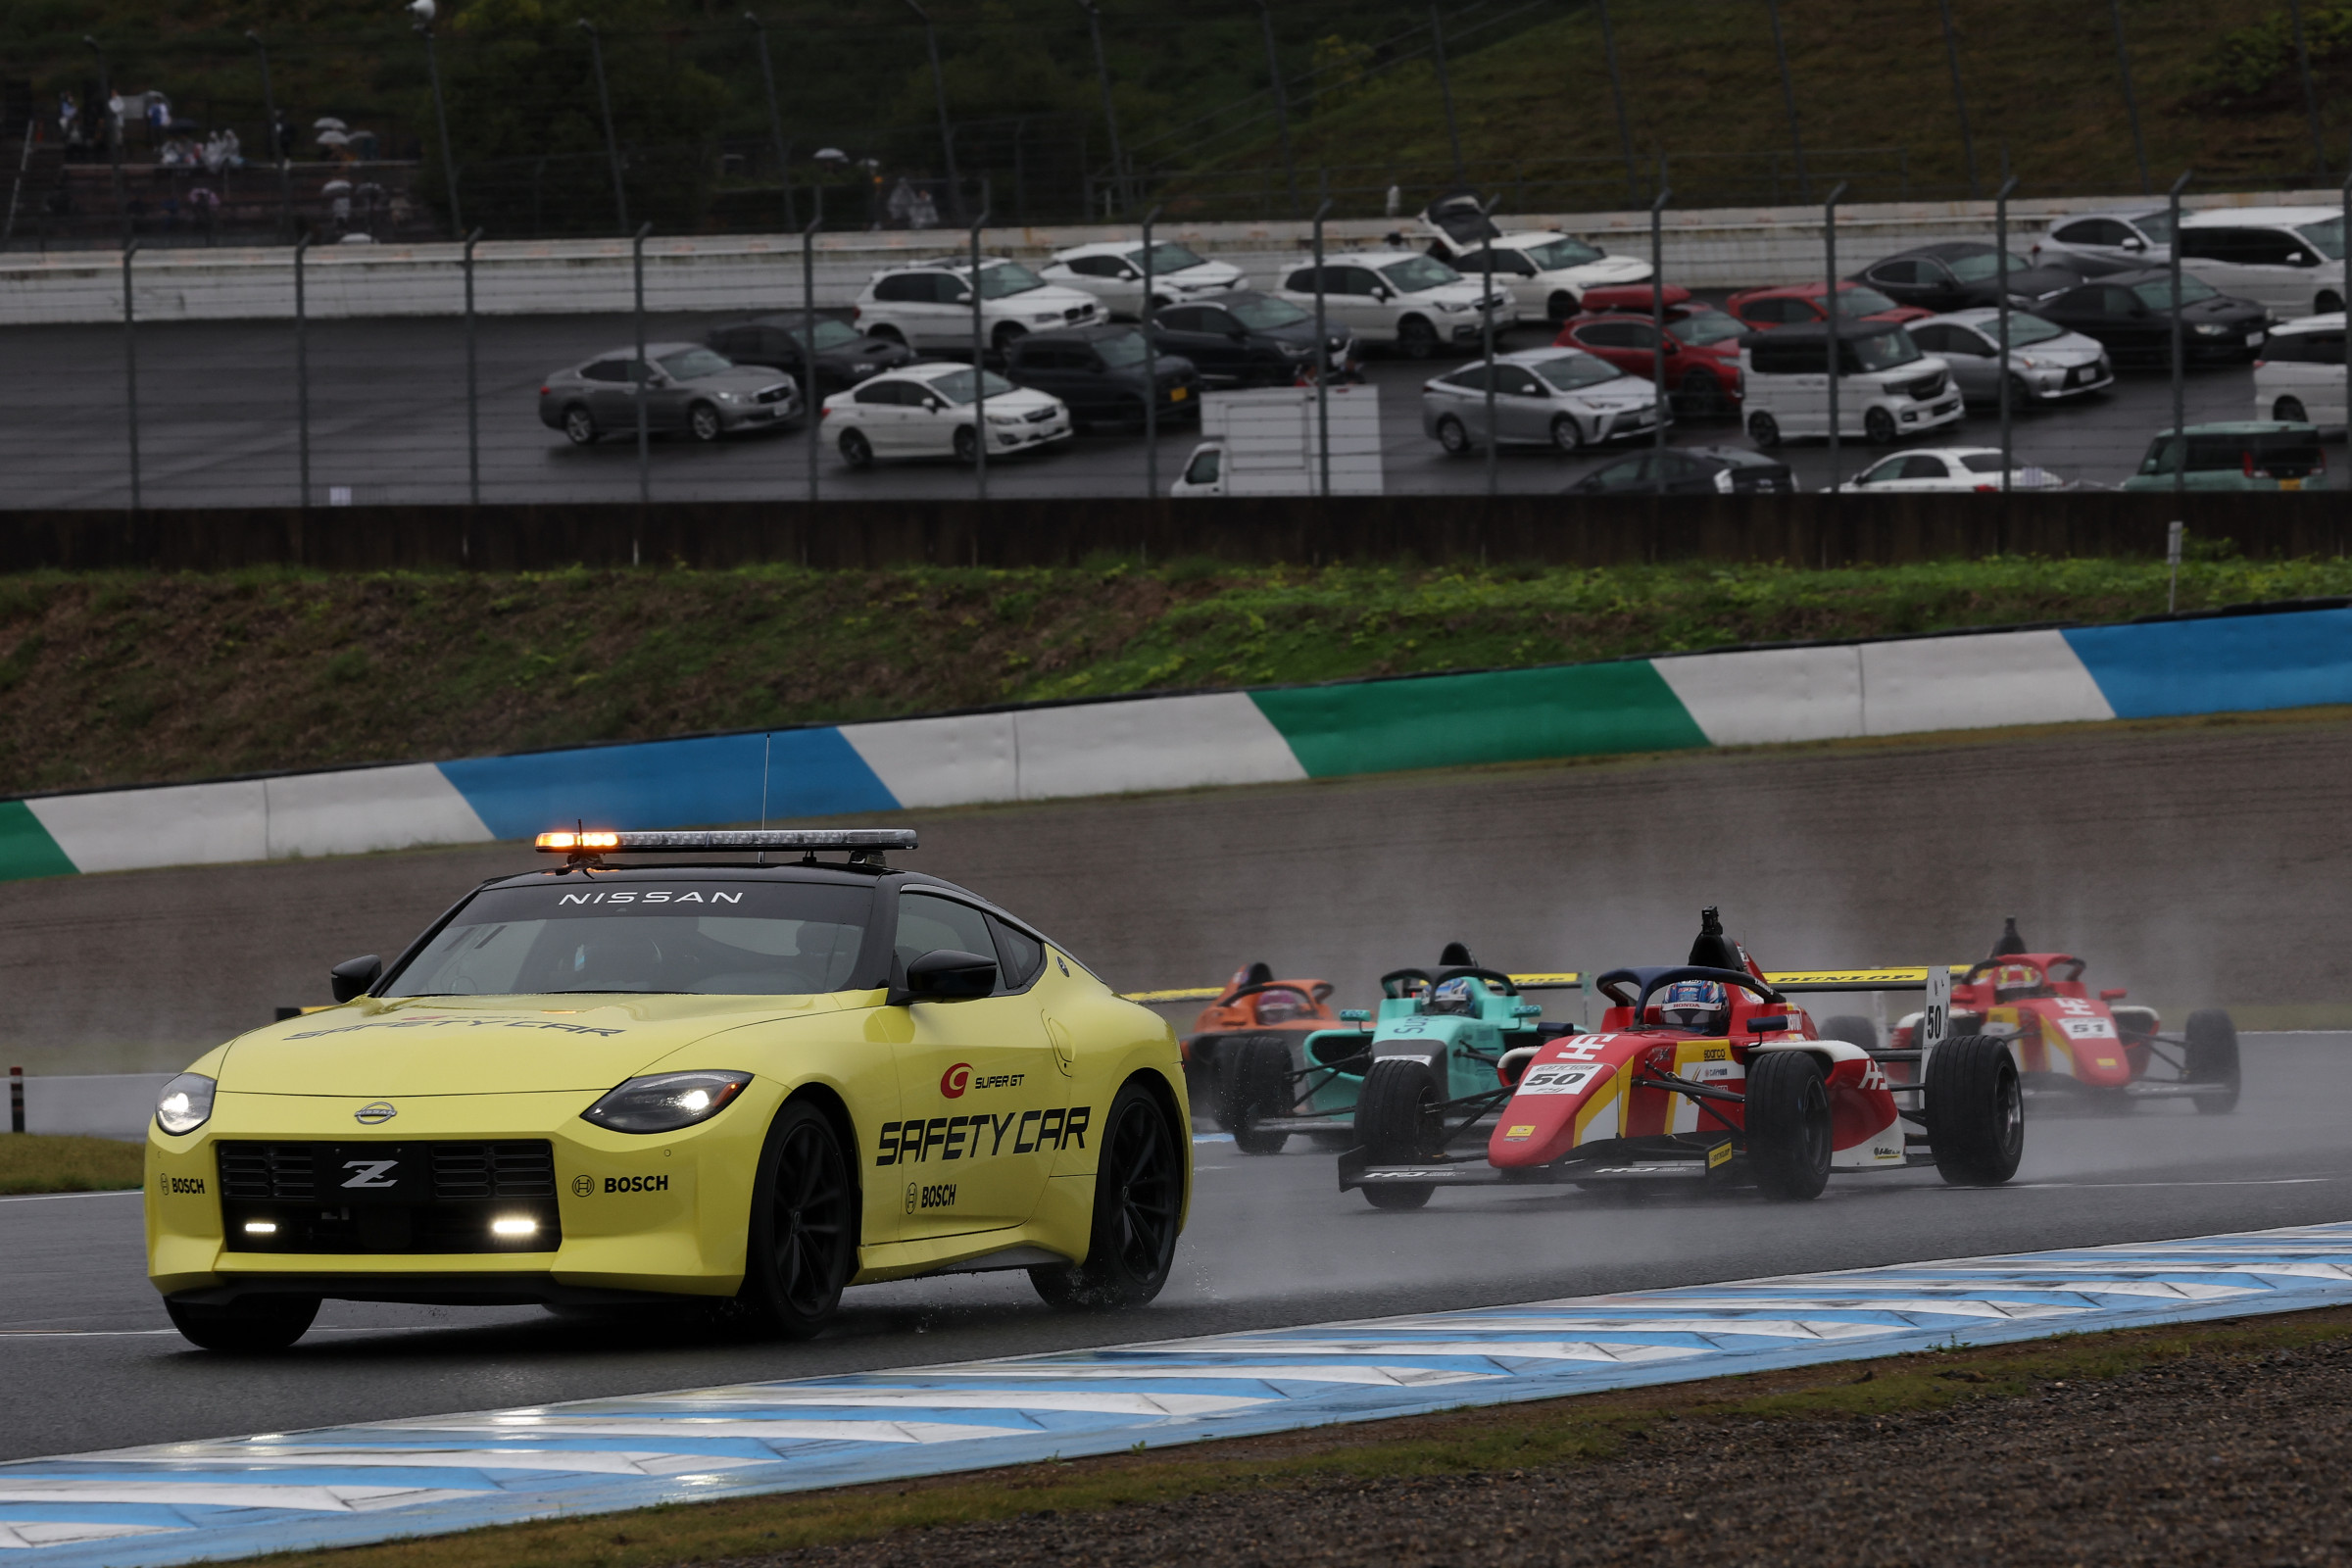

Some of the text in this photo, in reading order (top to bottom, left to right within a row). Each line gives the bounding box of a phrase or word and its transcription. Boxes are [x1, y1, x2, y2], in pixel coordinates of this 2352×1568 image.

[559, 892, 743, 905] NISSAN
[281, 1020, 627, 1041] SAFETY CAR
[1928, 1005, 1941, 1039] 50
[2073, 1023, 2105, 1033] 51
[1704, 1049, 1726, 1058] sparco
[975, 1074, 1025, 1089] SUPER GT
[1524, 1072, 1586, 1087] 50
[876, 1106, 1092, 1166] SAFETY CAR
[172, 1177, 206, 1195] BOSCH
[604, 1175, 668, 1194] BOSCH
[921, 1184, 956, 1208] BOSCH
